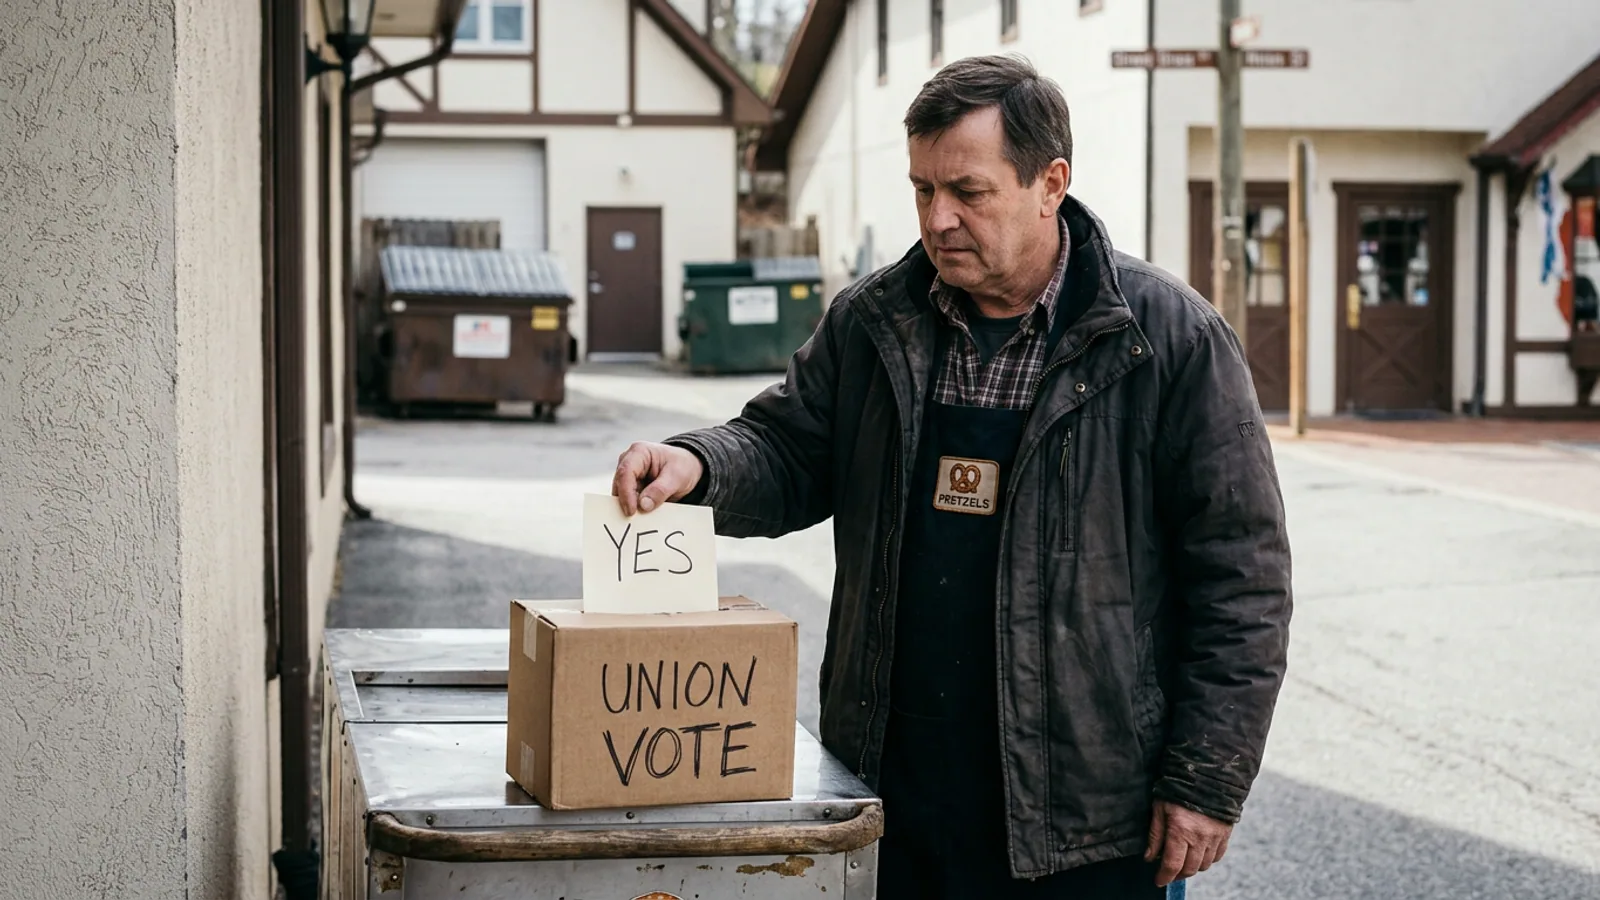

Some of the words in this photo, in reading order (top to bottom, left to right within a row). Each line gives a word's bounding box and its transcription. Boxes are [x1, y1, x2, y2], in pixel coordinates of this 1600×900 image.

[938, 494, 990, 508] PRETZELS
[603, 523, 693, 581] YES
[602, 655, 757, 714] UNION
[602, 721, 757, 786] VOTE
